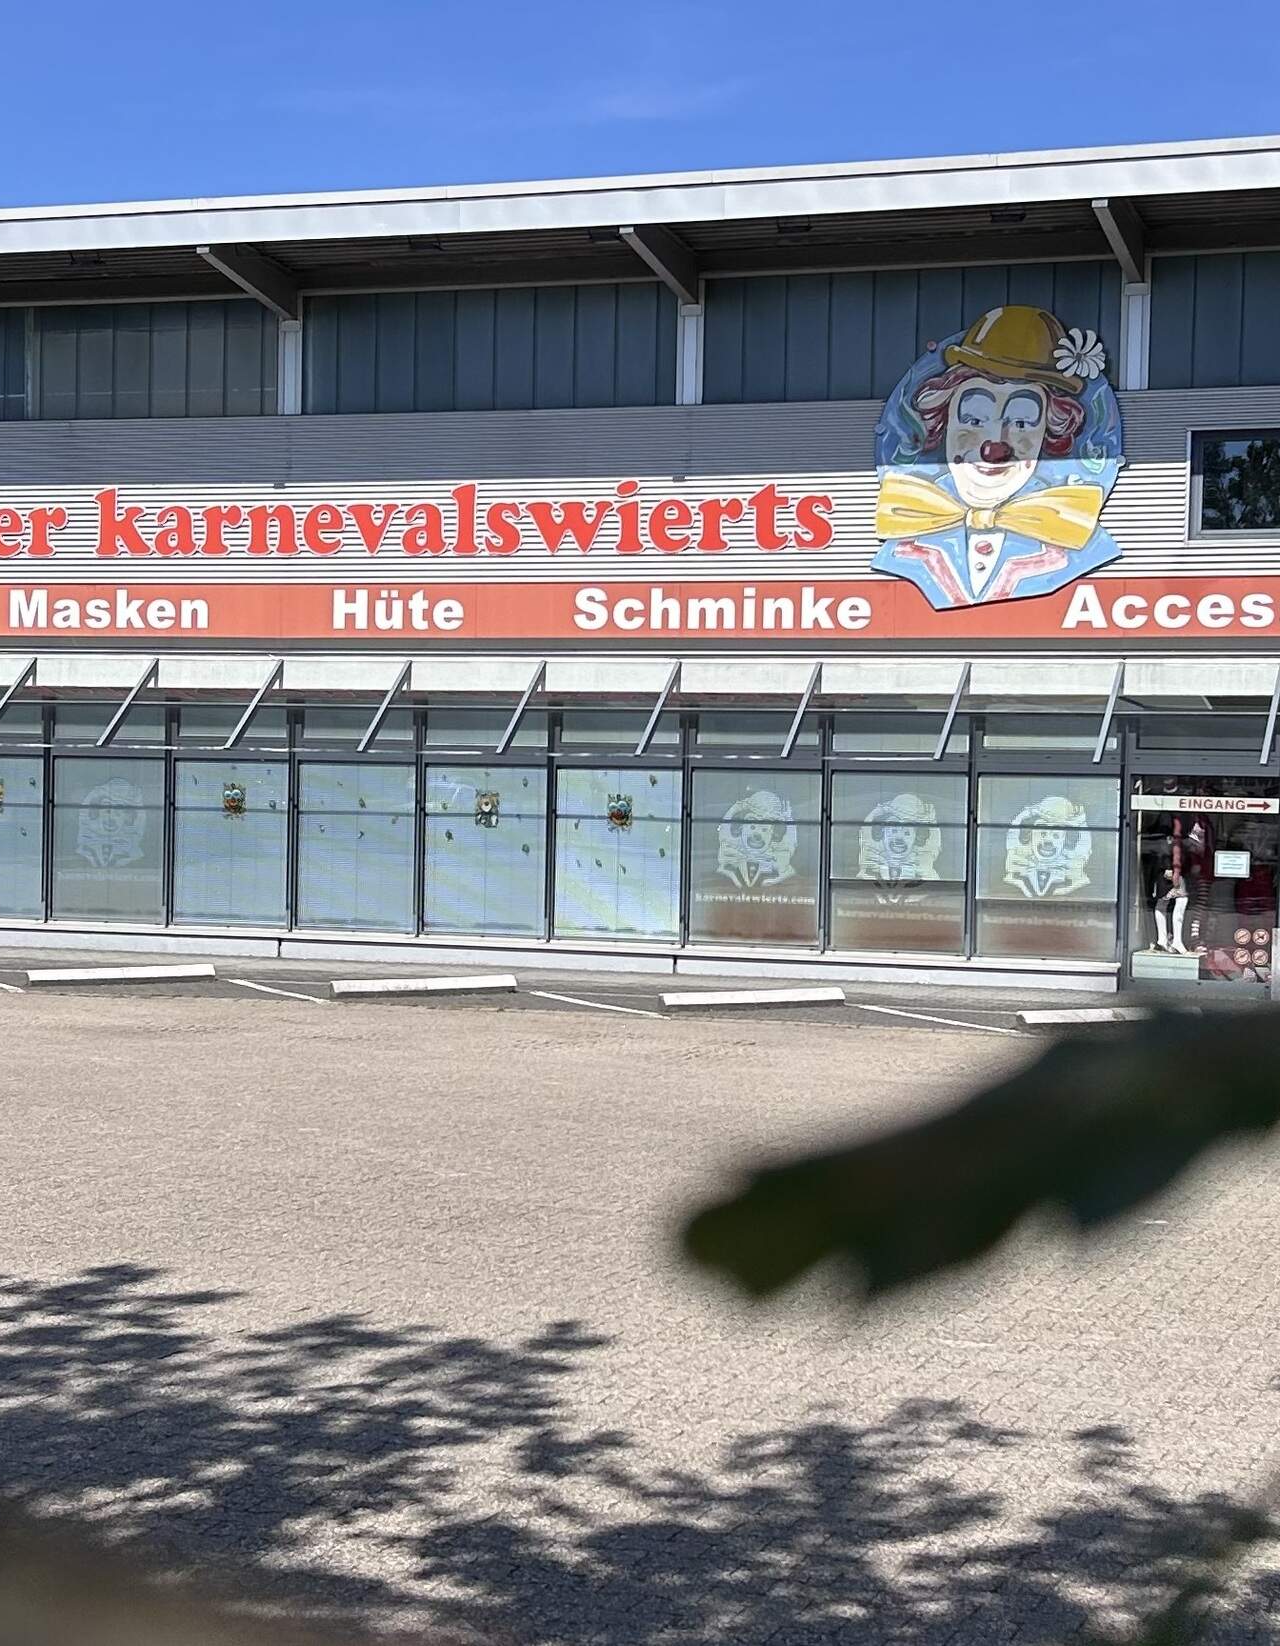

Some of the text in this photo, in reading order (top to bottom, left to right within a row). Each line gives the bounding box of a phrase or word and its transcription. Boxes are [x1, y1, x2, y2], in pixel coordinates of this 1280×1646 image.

[94, 479, 834, 557] karnevalswierts
[9, 589, 209, 630] Masken
[332, 589, 465, 631] Hüte
[573, 588, 872, 631] Schminke
[1179, 798, 1246, 811] EINGANG
